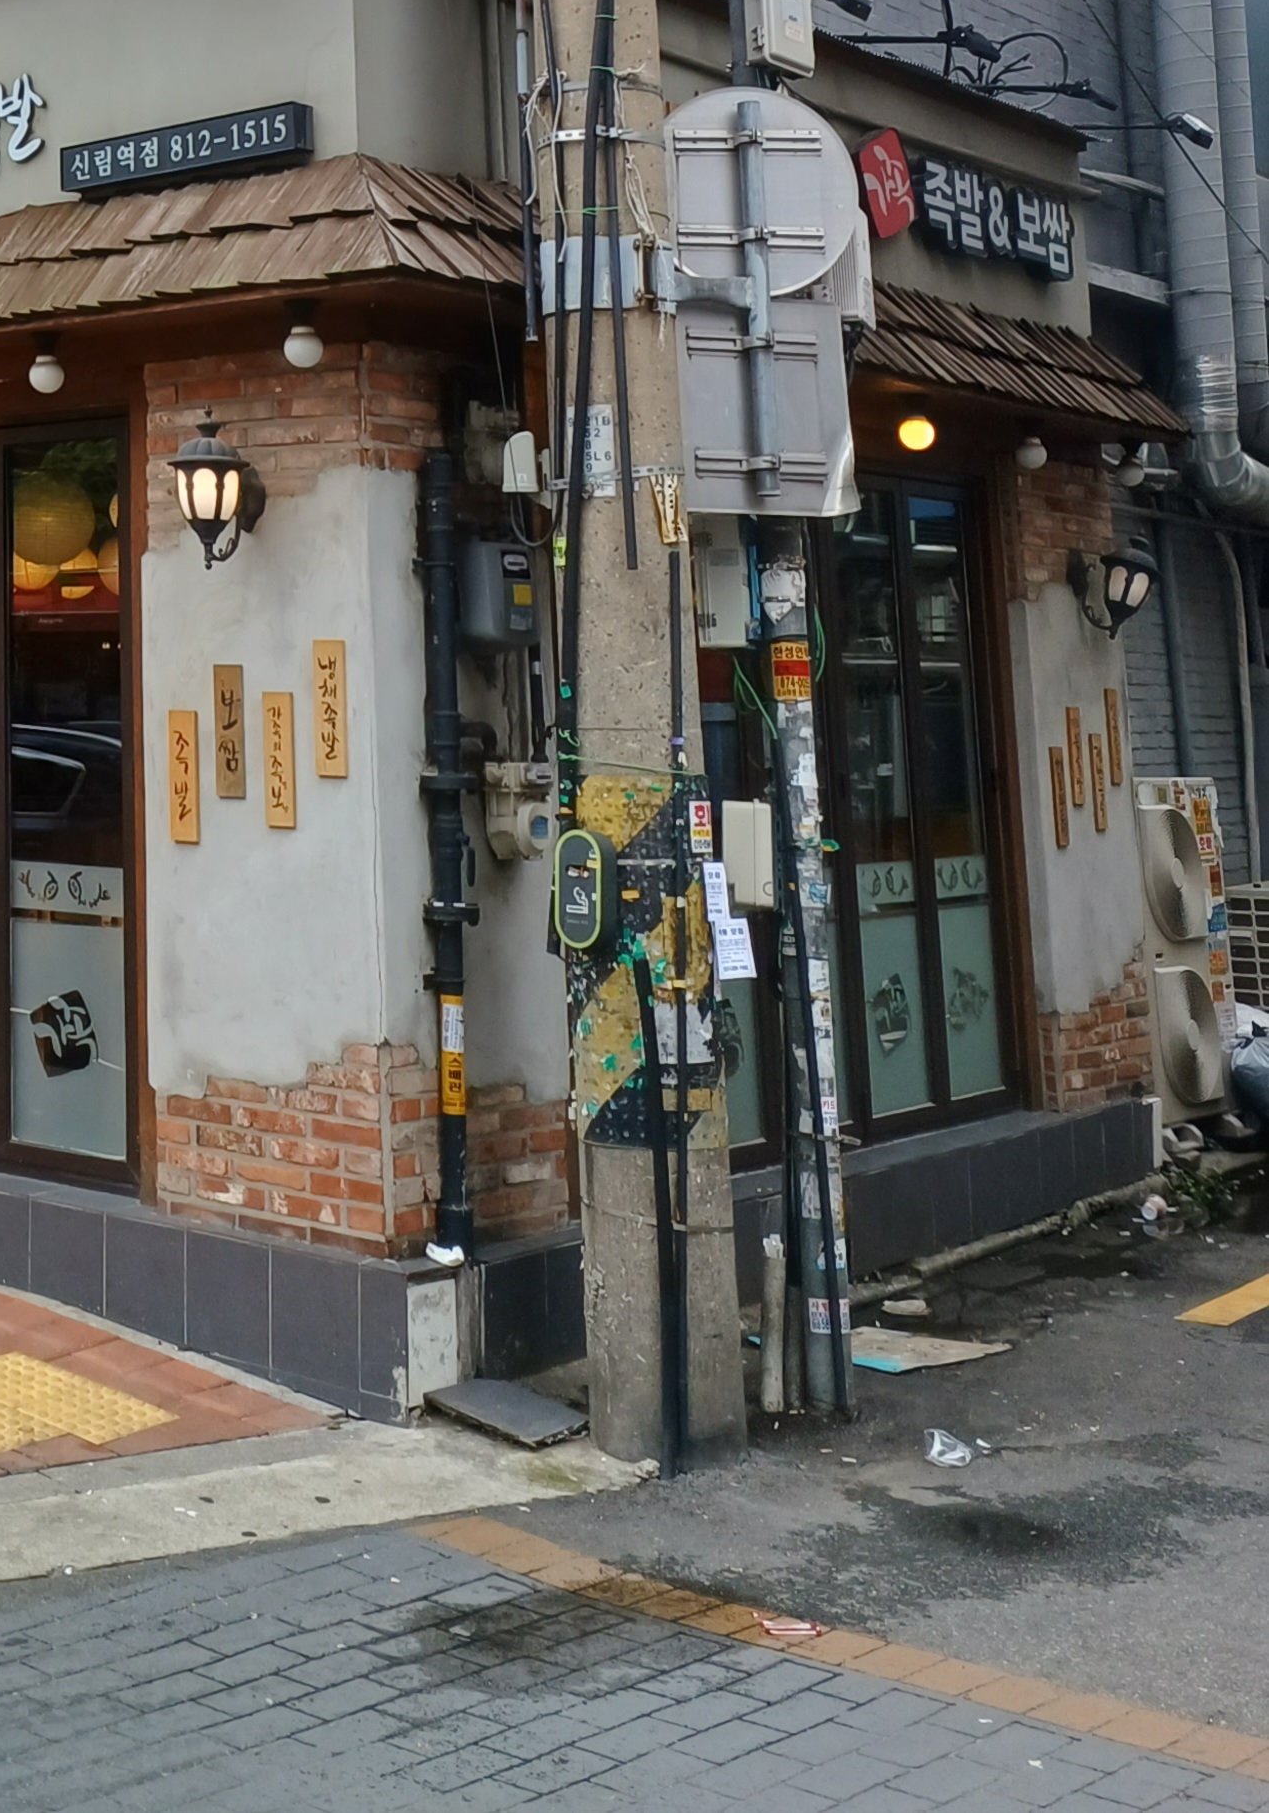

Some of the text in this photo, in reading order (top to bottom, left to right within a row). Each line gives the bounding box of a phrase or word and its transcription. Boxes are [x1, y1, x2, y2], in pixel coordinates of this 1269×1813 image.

[70, 113, 287, 182] 신림역점 812-1515
[217, 687, 242, 773] 보쌈
[317, 655, 340, 761] 냉채족발
[173, 729, 192, 822] 족발
